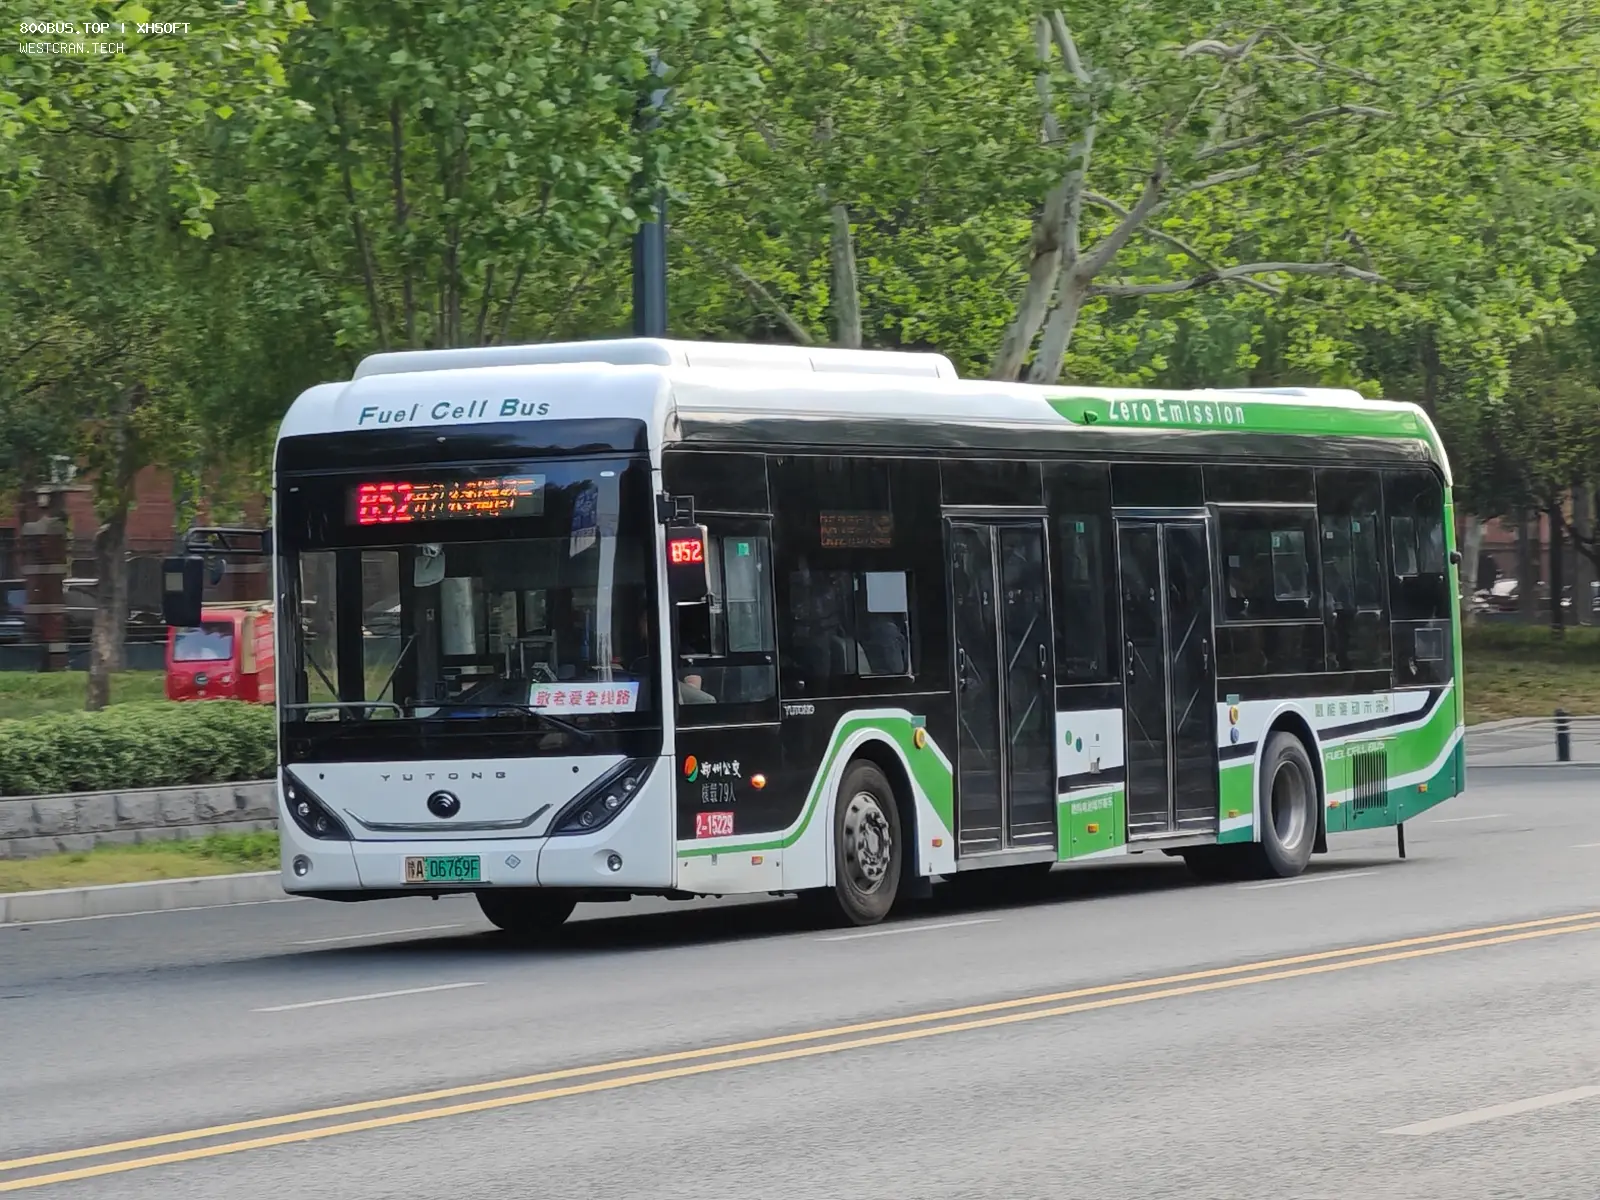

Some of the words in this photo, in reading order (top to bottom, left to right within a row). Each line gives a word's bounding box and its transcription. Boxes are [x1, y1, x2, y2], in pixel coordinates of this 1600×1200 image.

[358, 403, 419, 426] Fuel
[430, 400, 487, 420] Cell
[499, 398, 551, 418] Bus
[381, 771, 507, 782] YUTONG
[700, 760, 742, 778] 郑州公交
